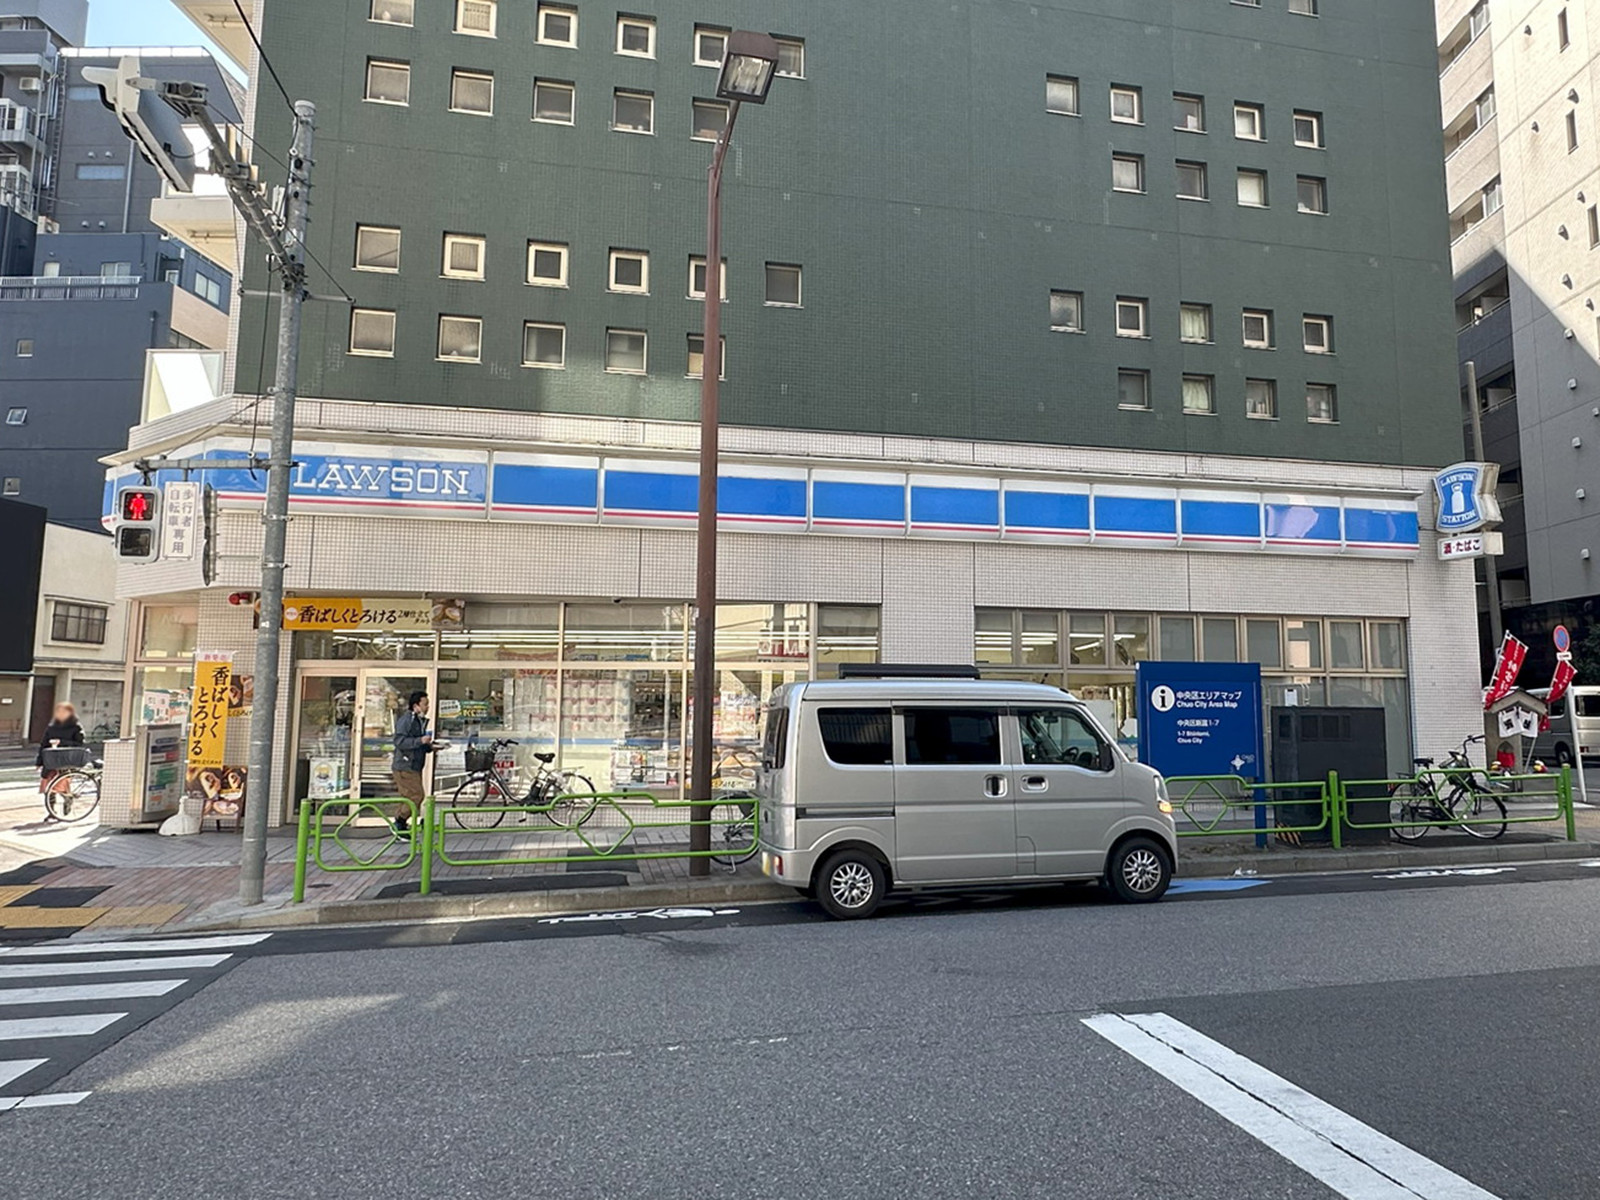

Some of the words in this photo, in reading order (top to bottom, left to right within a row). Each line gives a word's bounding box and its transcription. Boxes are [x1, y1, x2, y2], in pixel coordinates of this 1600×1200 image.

[293, 462, 469, 495] LAWSON
[1440, 473, 1475, 487] LAWSON
[168, 490, 180, 526] 自転車
[182, 489, 193, 527] 歩行者
[1442, 510, 1476, 523] STATION
[172, 529, 185, 553] 専用
[299, 605, 397, 624] 香ばしくとろける
[210, 666, 229, 738] 香ばしく
[1176, 690, 1242, 700] 中央区エリアマップ
[1176, 700, 1194, 708] Chuo
[1194, 700, 1207, 709] City
[1208, 700, 1223, 708] Area
[1224, 700, 1238, 709] Map
[191, 687, 208, 756] とろける
